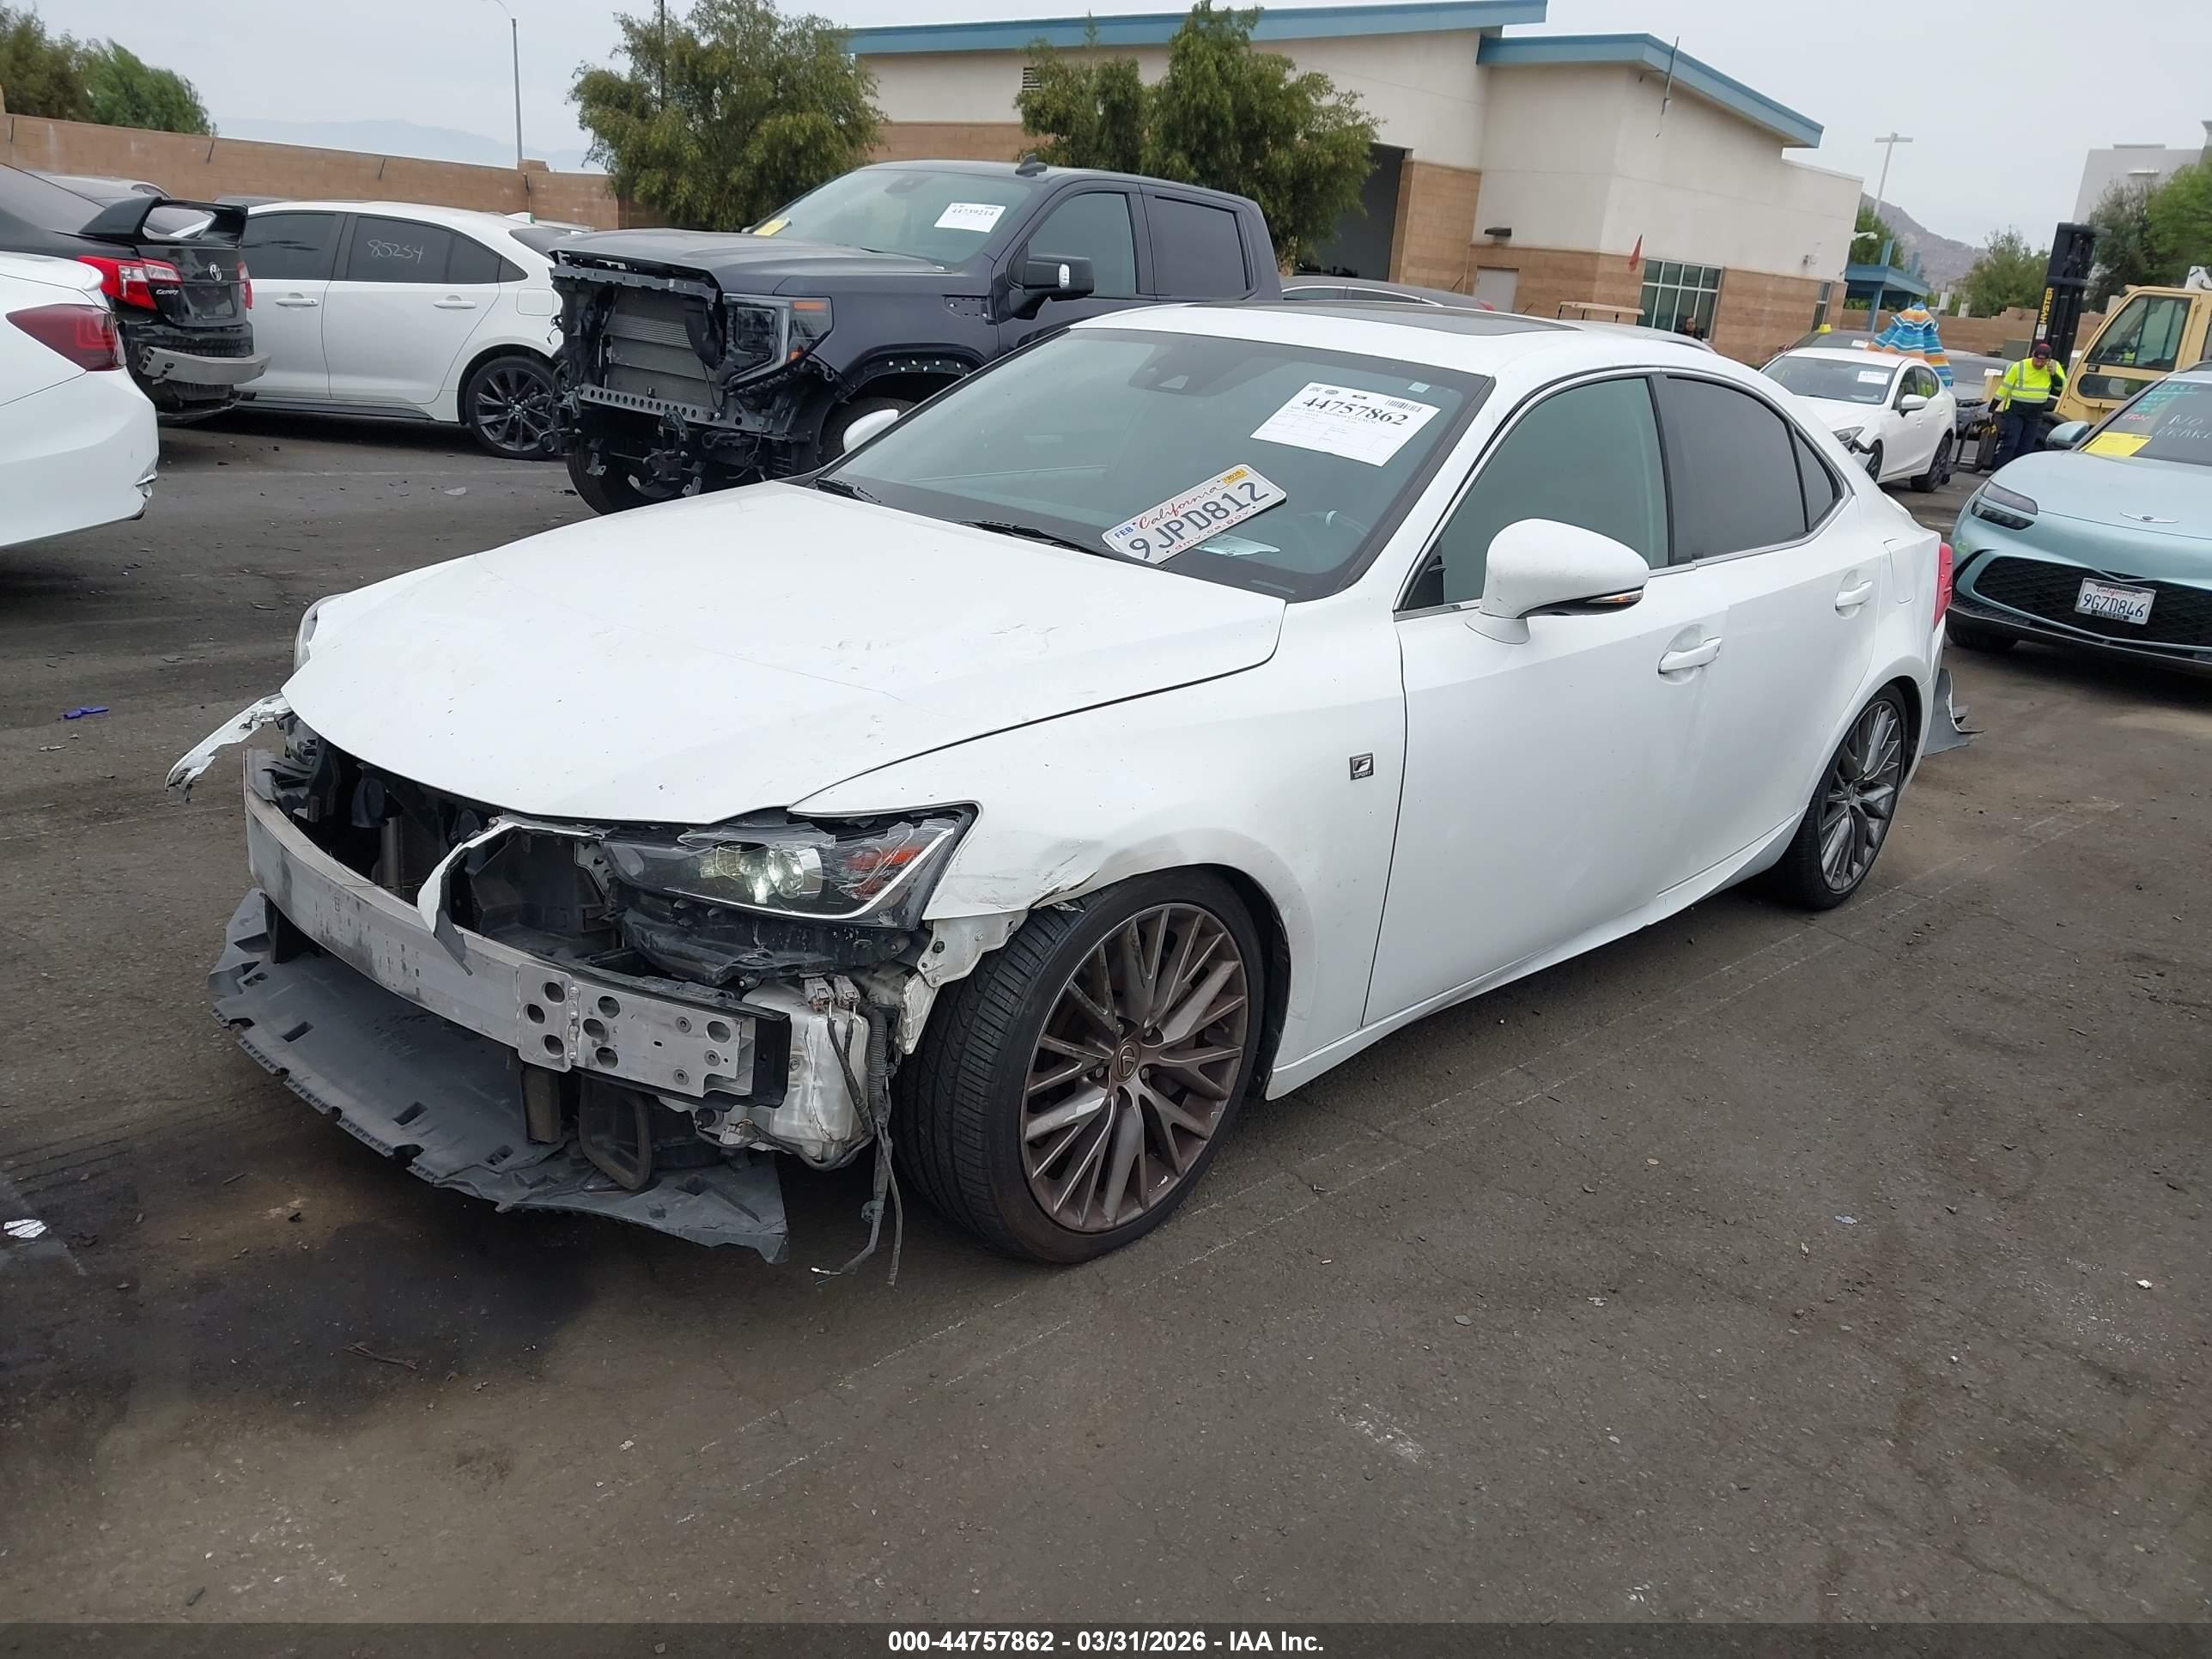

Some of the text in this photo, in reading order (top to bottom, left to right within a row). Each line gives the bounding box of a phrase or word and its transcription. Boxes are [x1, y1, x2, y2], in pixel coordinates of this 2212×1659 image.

[2039, 288, 2054, 324] HYSTER
[1302, 397, 1409, 426] 44757862
[1128, 482, 1270, 560] 9JPD812
[1139, 483, 1230, 530] California
[1115, 526, 1134, 539] FEB
[2082, 592, 2147, 617] 9GZD846
